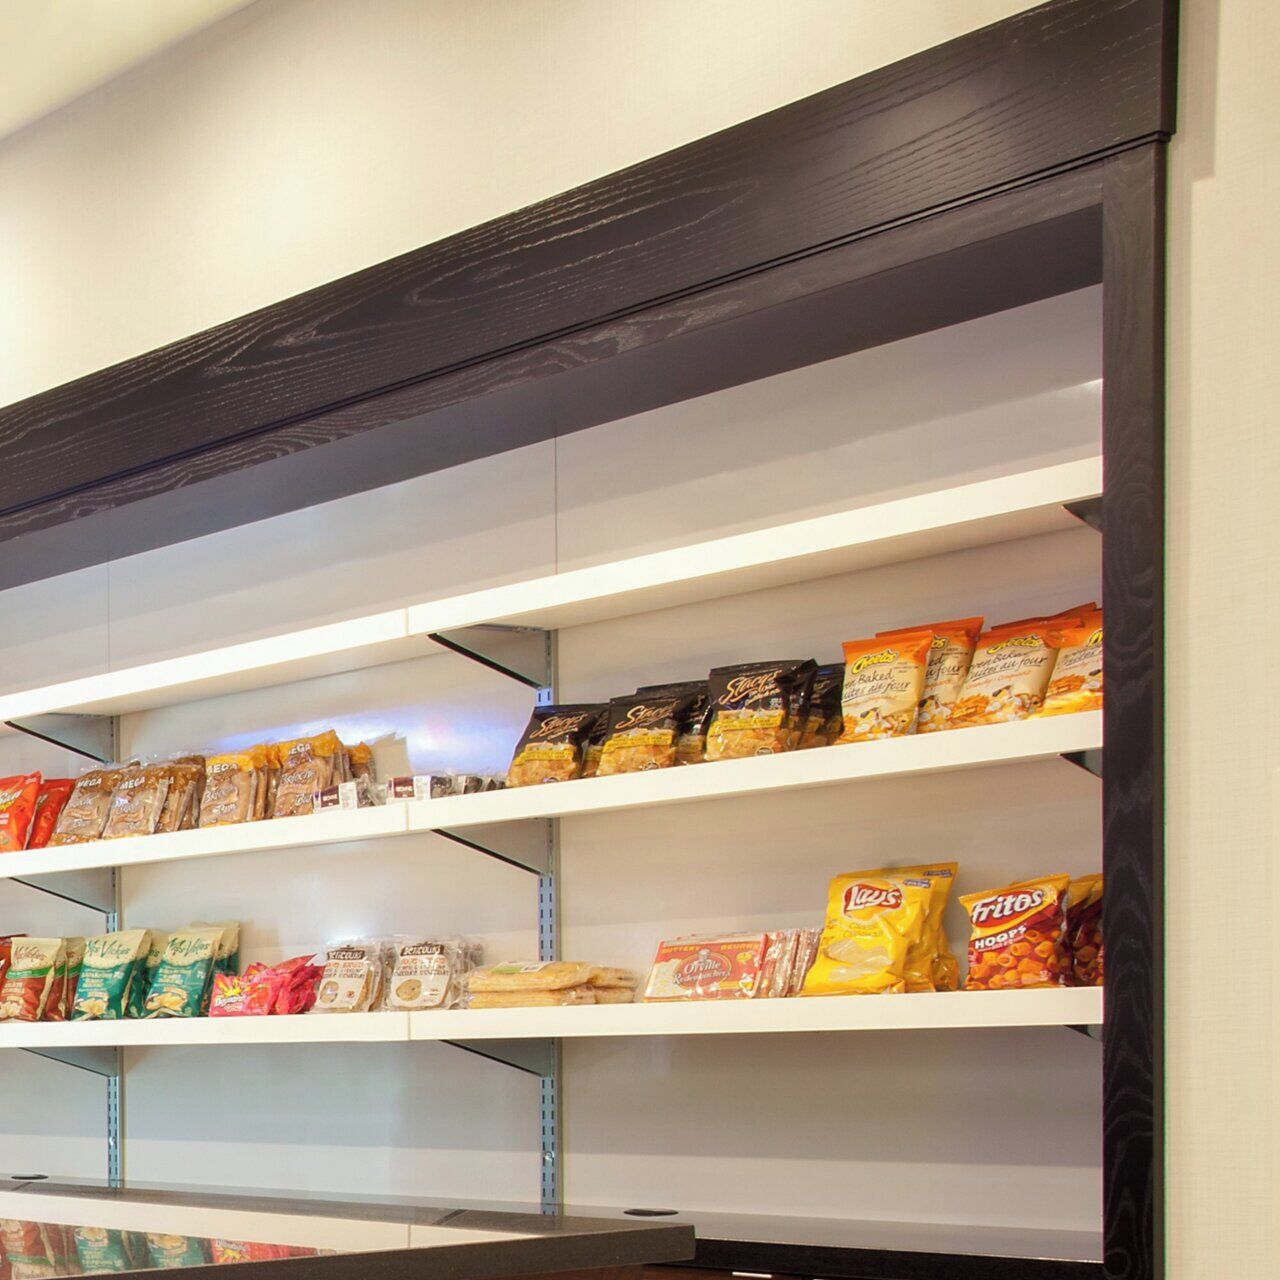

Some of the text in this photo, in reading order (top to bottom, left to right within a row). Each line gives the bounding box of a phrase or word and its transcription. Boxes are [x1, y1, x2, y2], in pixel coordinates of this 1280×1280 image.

[851, 650, 898, 674] Cheetos
[858, 668, 894, 684] Baked
[881, 680, 912, 695] four
[77, 777, 102, 787] MEGA
[119, 776, 145, 790] MEGA
[847, 885, 901, 911] Lay's
[972, 889, 1043, 923] Fritos
[975, 925, 1027, 949] HOOPS
[684, 960, 721, 974] Orville
